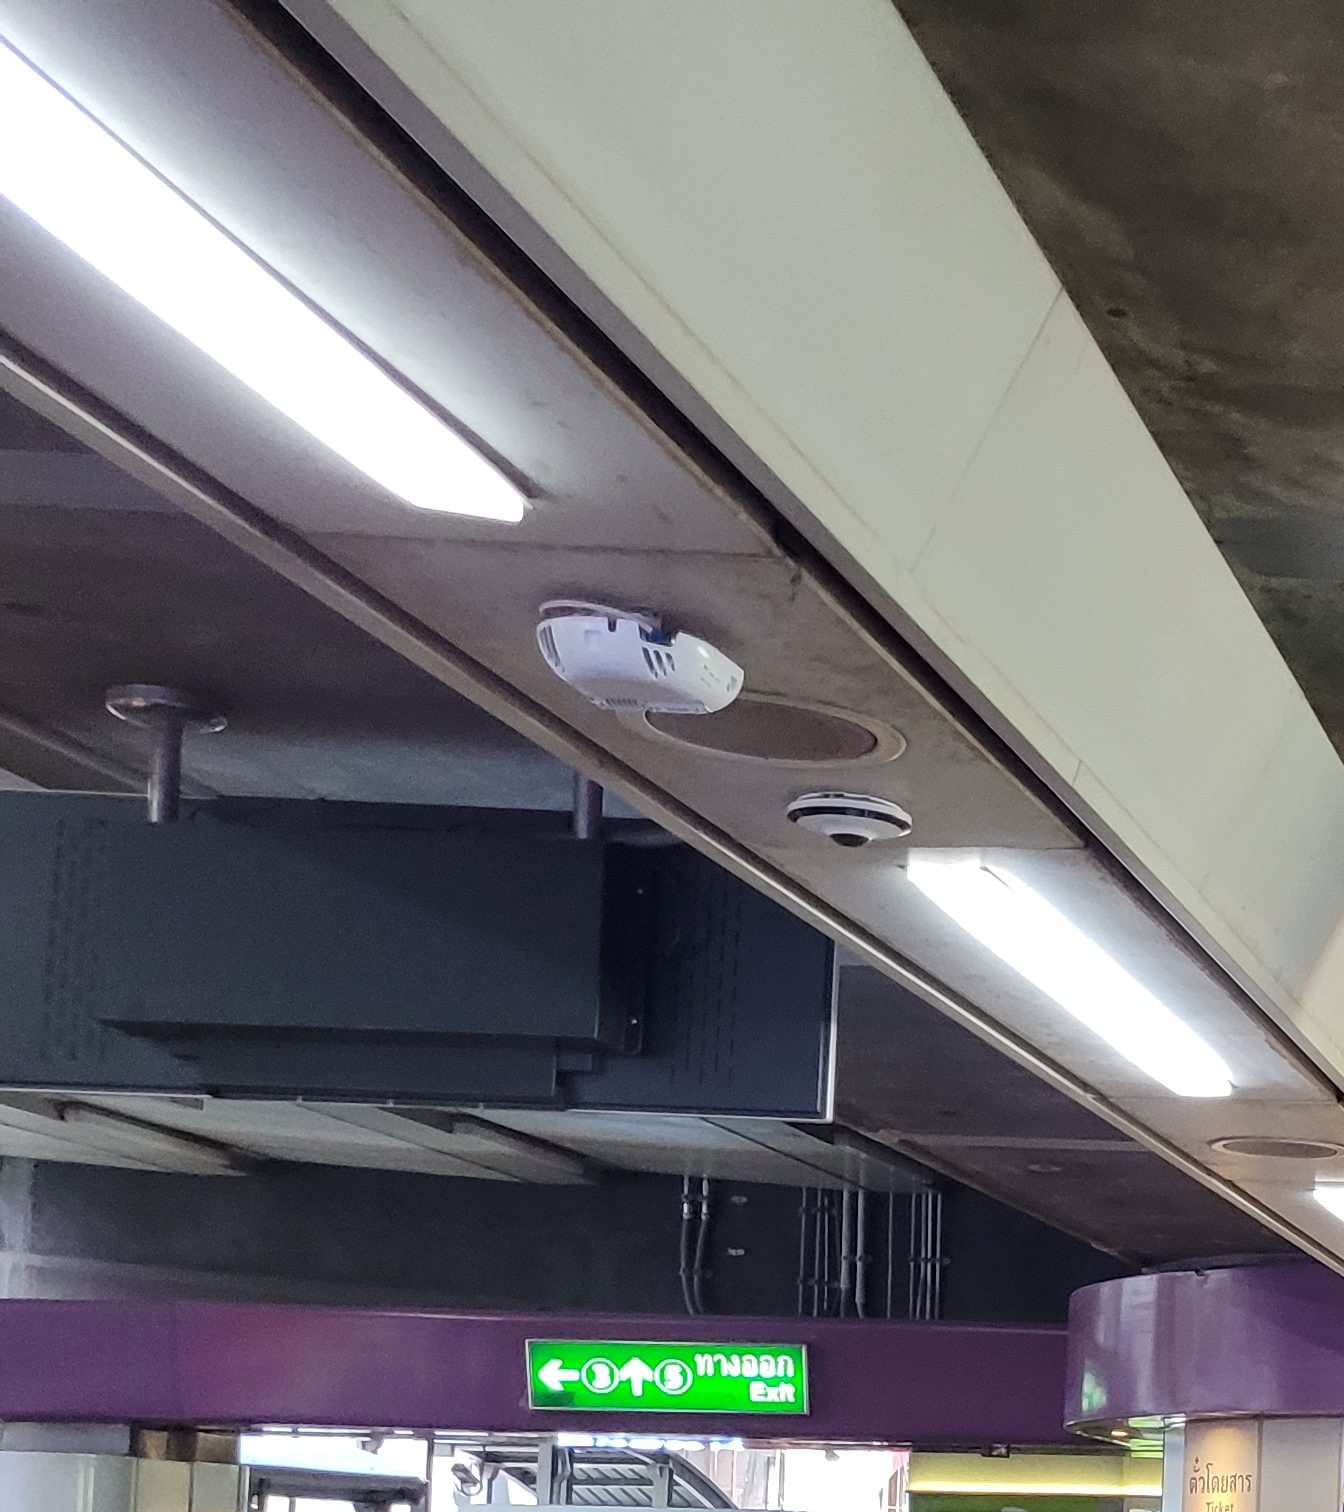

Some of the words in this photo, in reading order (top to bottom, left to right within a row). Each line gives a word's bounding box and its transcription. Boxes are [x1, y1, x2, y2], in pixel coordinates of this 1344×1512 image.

[694, 1353, 795, 1379] ทางออก
[749, 1382, 796, 1403] Exit
[1189, 1456, 1253, 1495] ตั๋วโดยสาร
